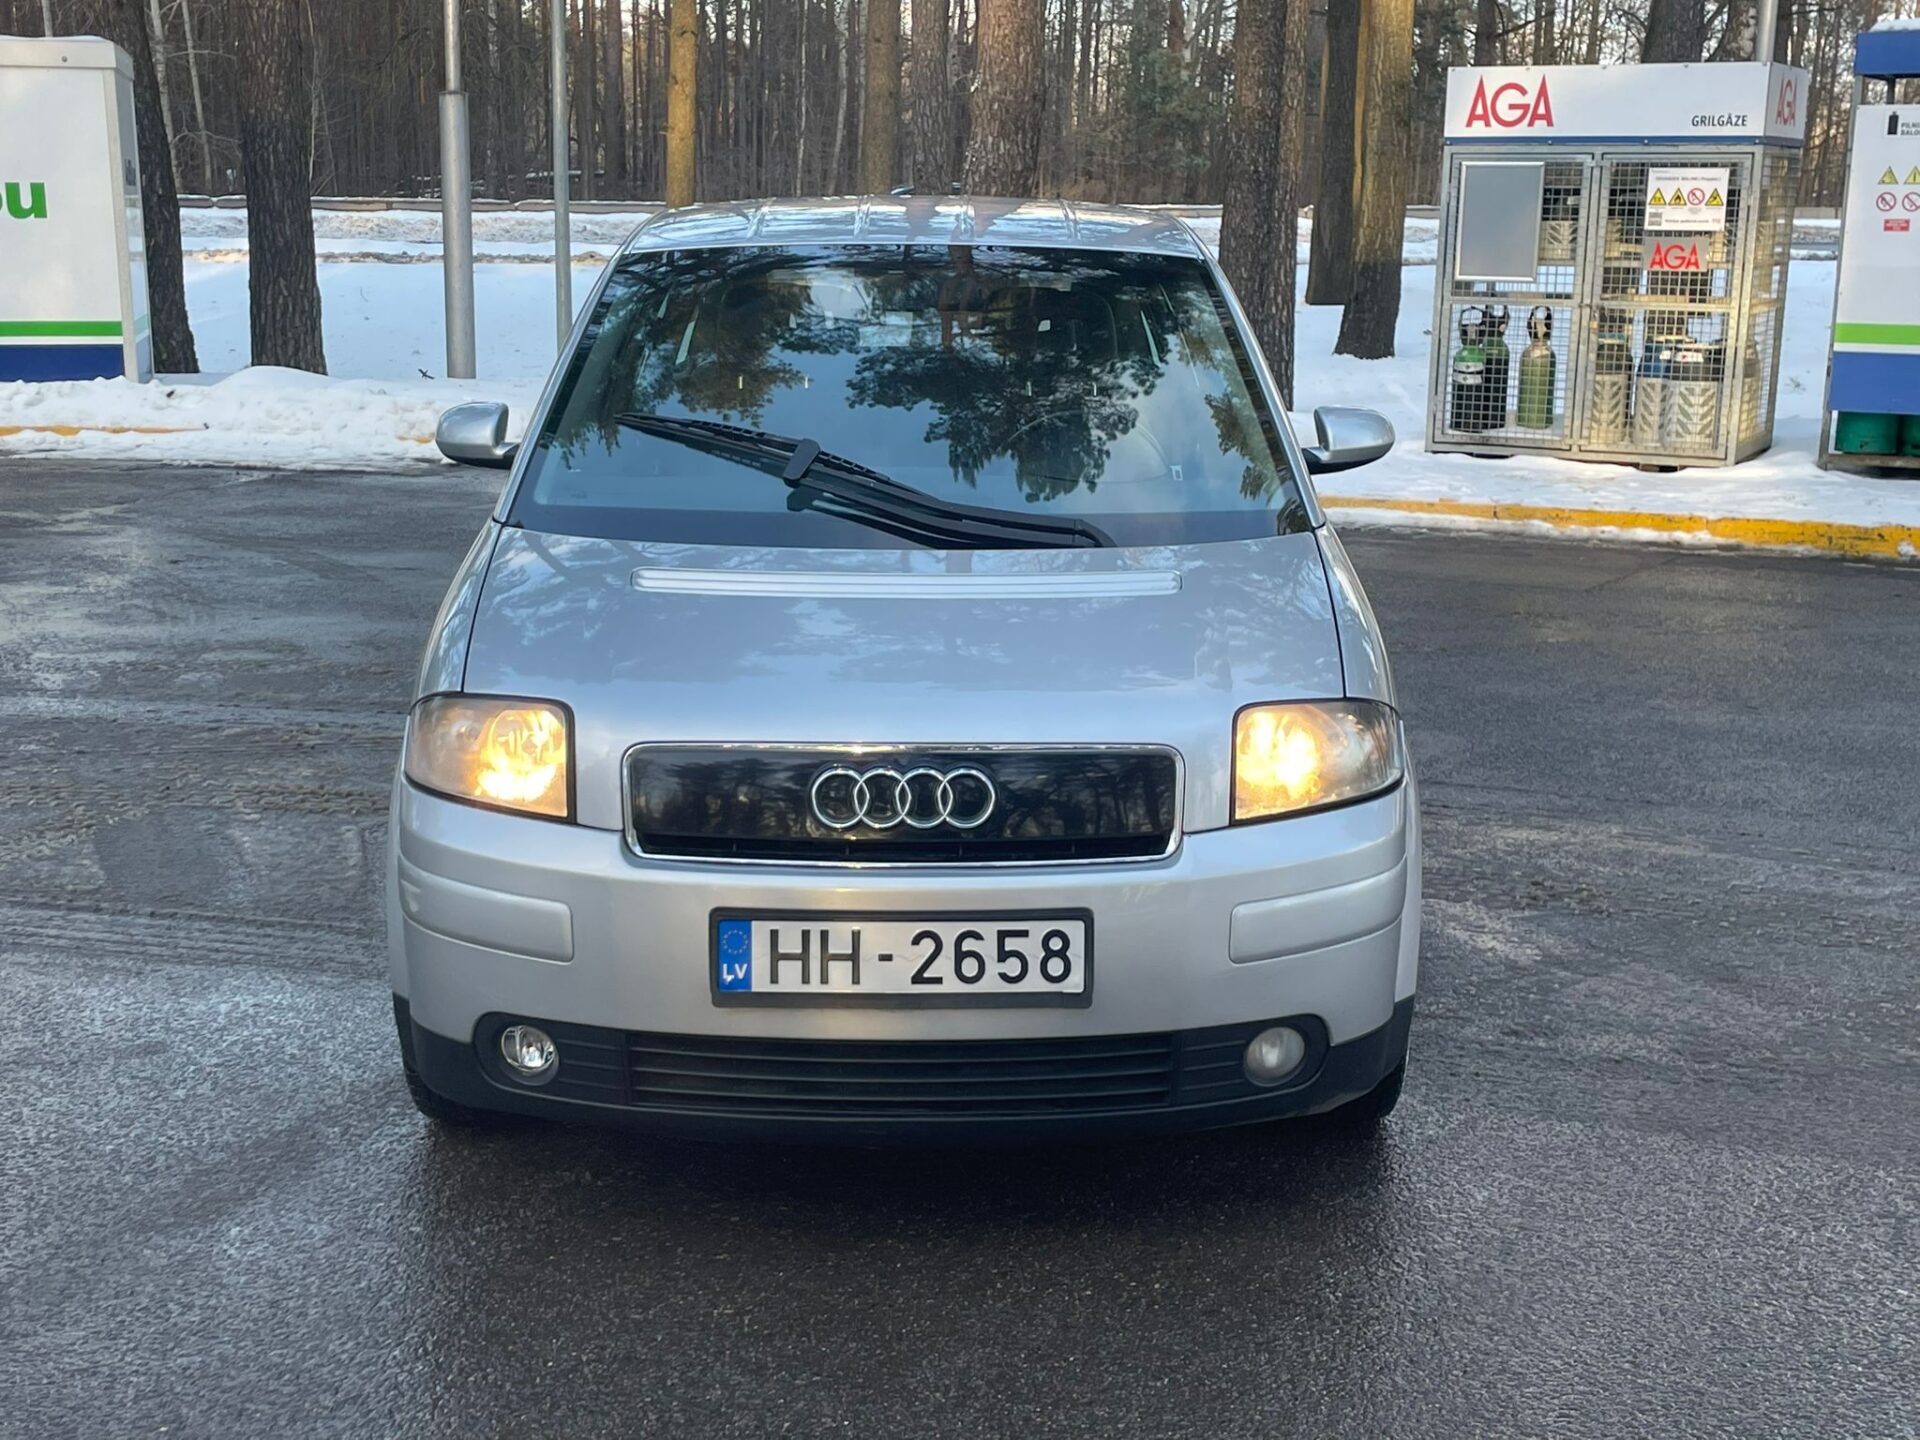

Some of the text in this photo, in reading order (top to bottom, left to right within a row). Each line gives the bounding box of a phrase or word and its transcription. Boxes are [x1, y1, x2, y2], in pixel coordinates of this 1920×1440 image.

[1466, 74, 1554, 128] AGA
[1691, 113, 1748, 127] GRILGĀZE
[1775, 78, 1798, 127] AGA
[1650, 241, 1700, 270] AGA
[723, 963, 748, 981] LV
[769, 928, 1072, 985] HH-2658
